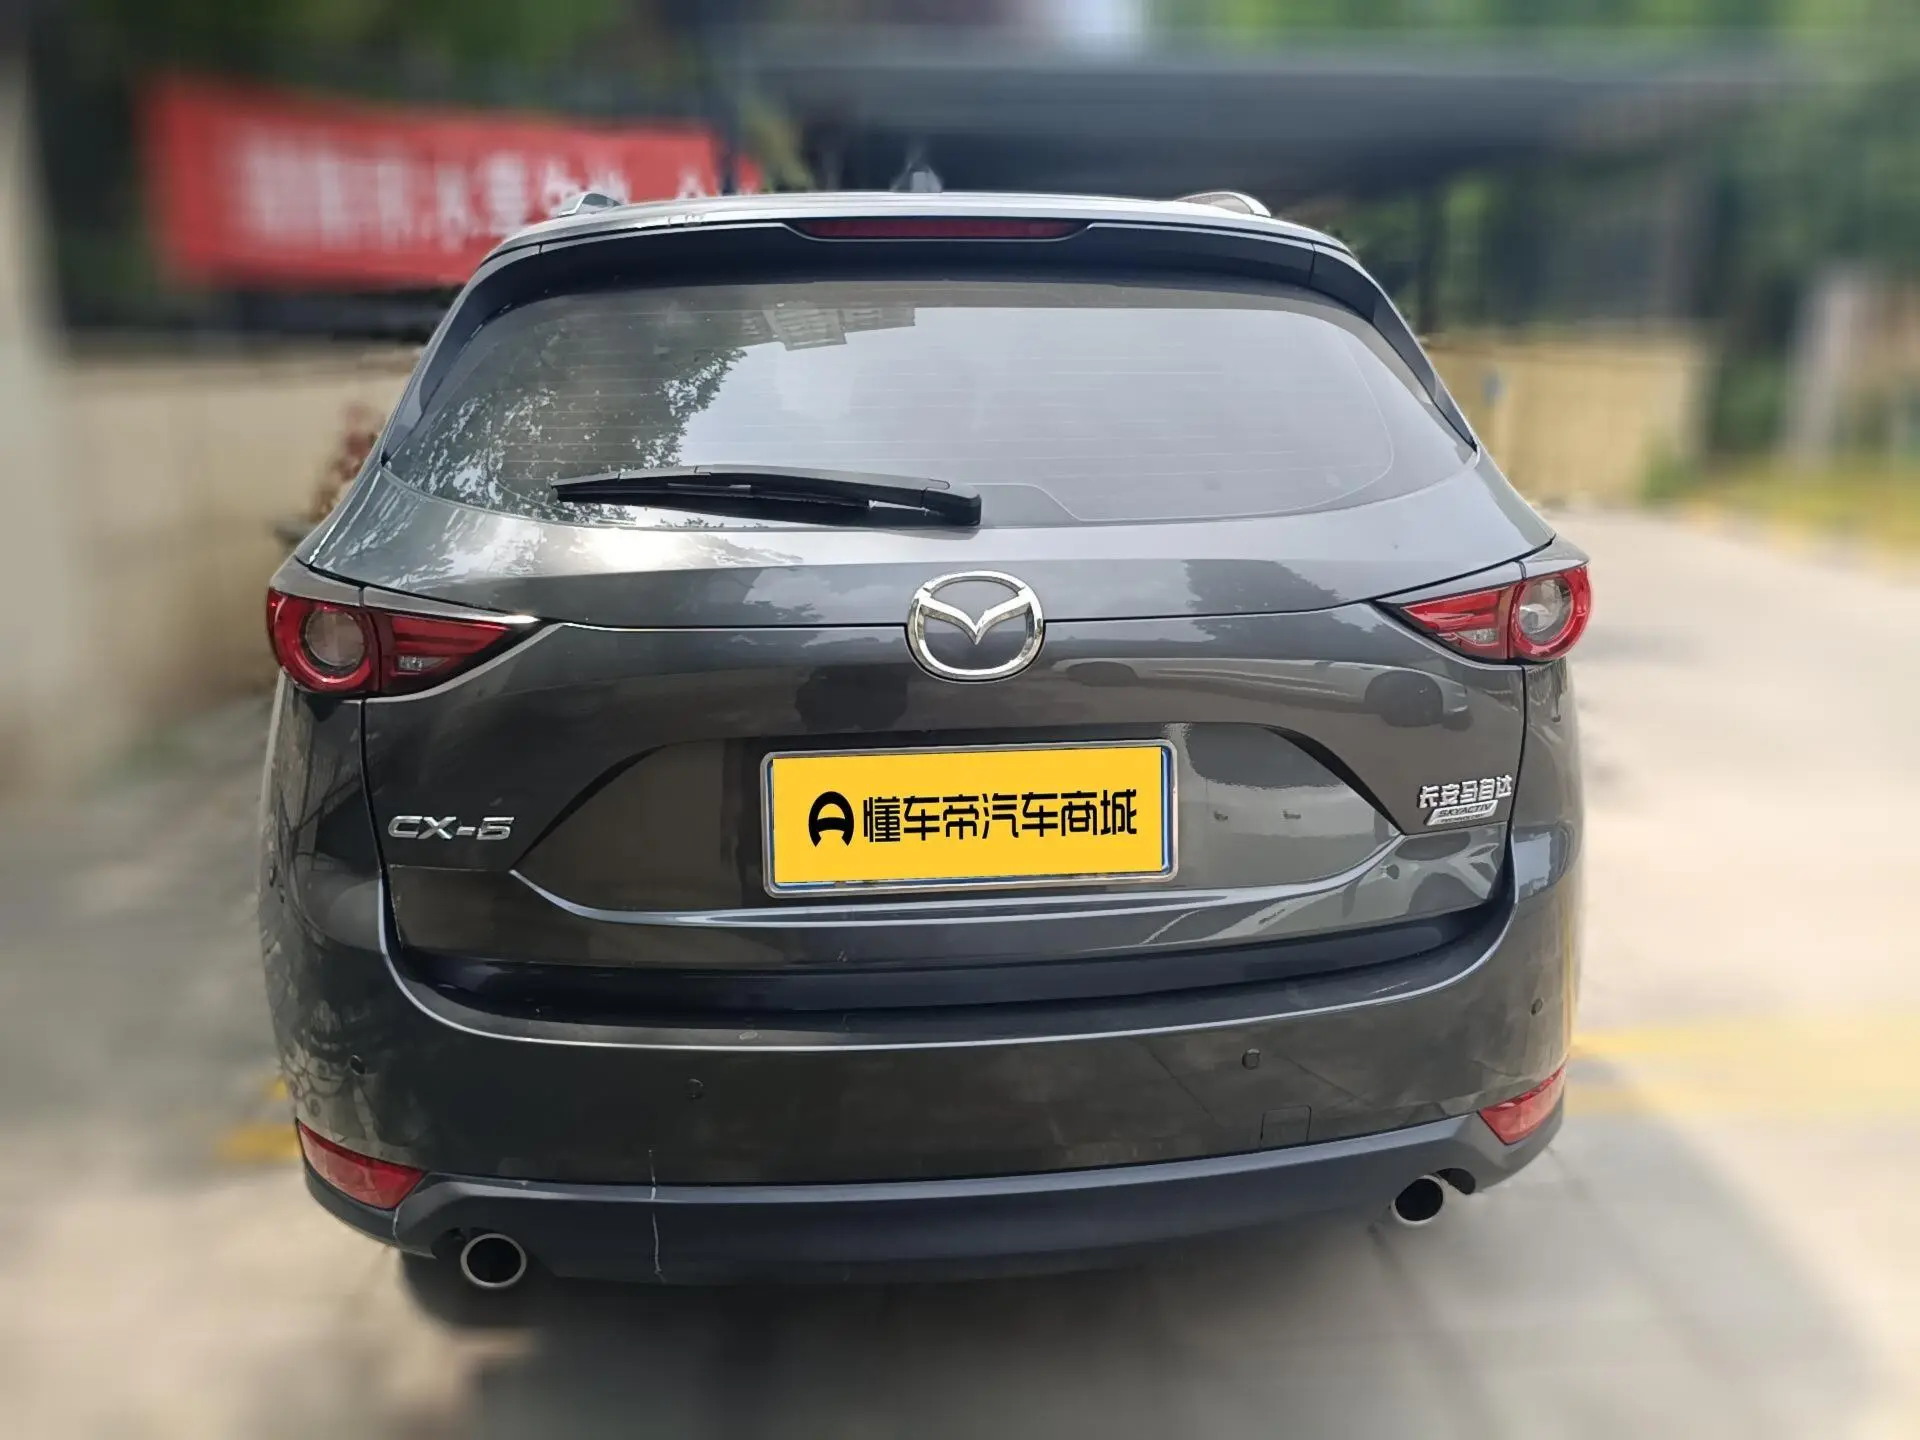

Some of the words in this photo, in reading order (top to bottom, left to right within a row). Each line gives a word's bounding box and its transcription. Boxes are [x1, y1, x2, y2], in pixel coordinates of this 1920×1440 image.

[1419, 774, 1512, 808] 长安马自达
[1438, 802, 1494, 817] SKYACTIV
[388, 815, 514, 840] CX-5
